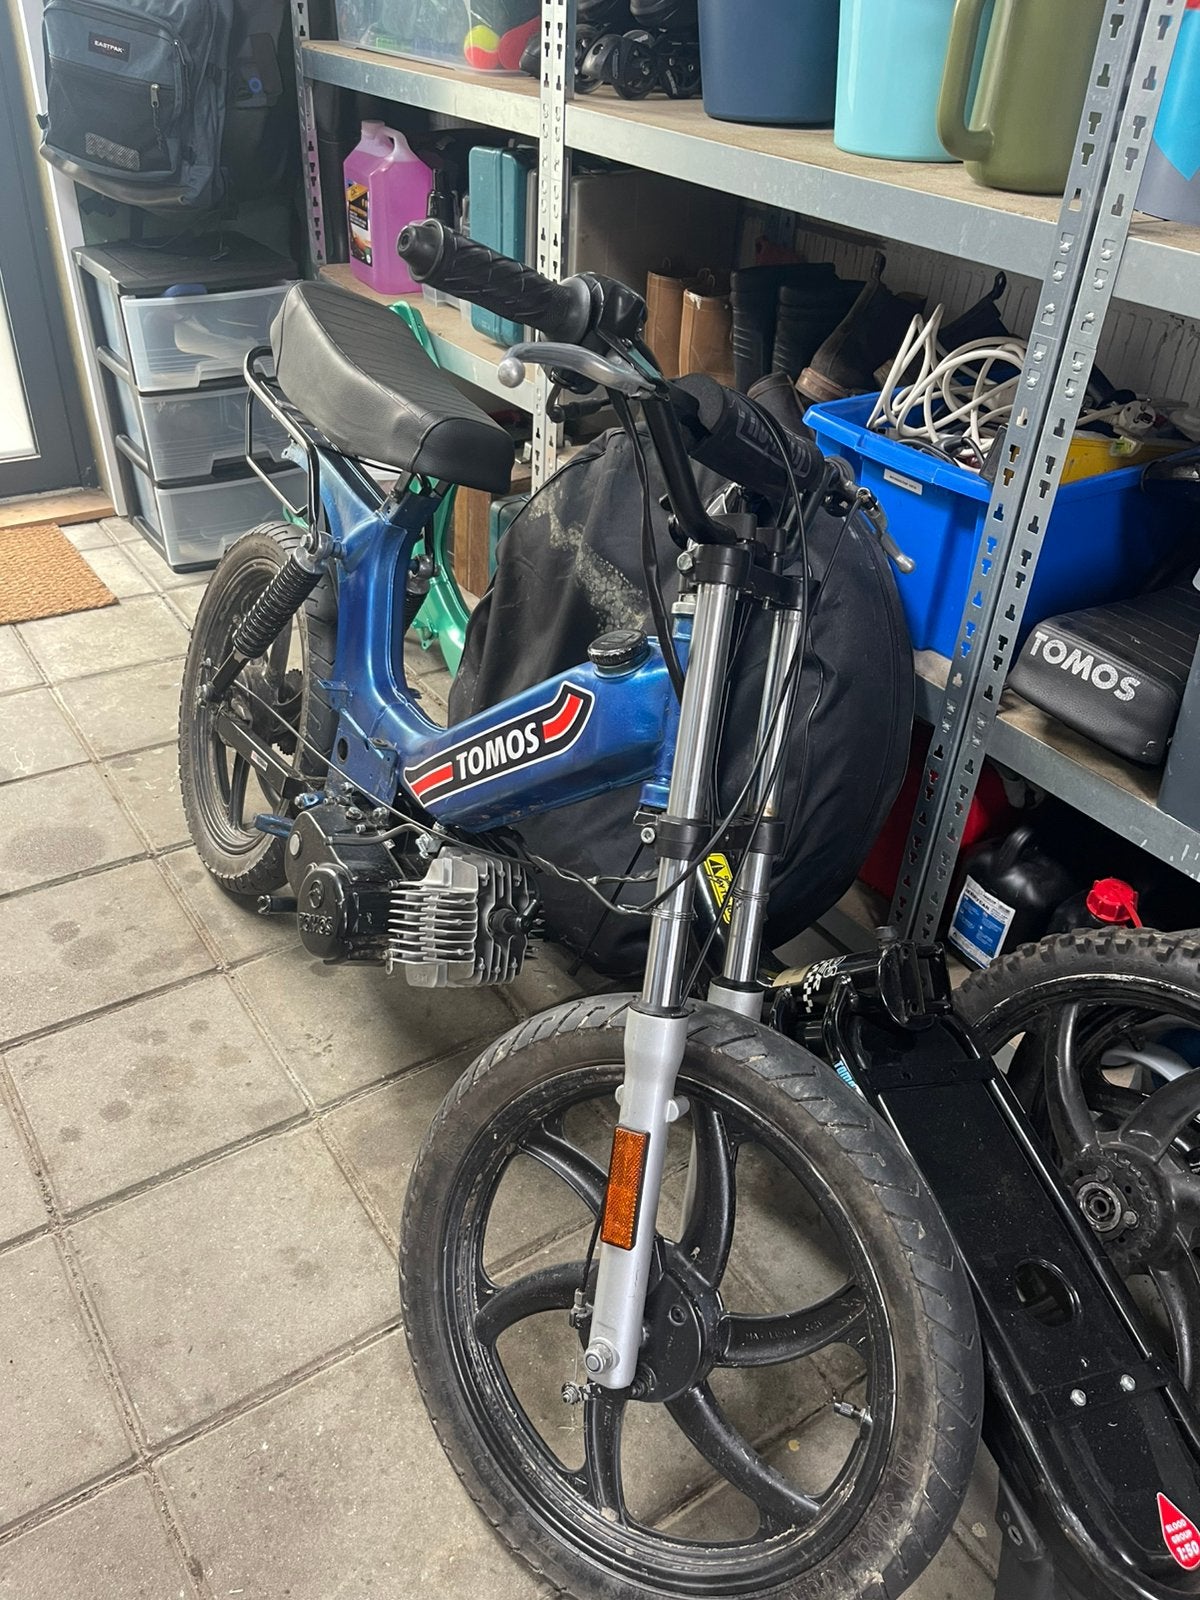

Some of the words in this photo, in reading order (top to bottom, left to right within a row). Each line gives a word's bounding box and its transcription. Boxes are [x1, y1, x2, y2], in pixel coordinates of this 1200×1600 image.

[94, 40, 123, 53] EASTPAK
[1030, 631, 1141, 701] TOMOS
[456, 722, 540, 780] TOMOS
[299, 911, 334, 935] TOMOS
[1165, 1518, 1187, 1534] BLOOD
[1171, 1529, 1192, 1544] GROUP
[1176, 1540, 1199, 1561] 1:50
